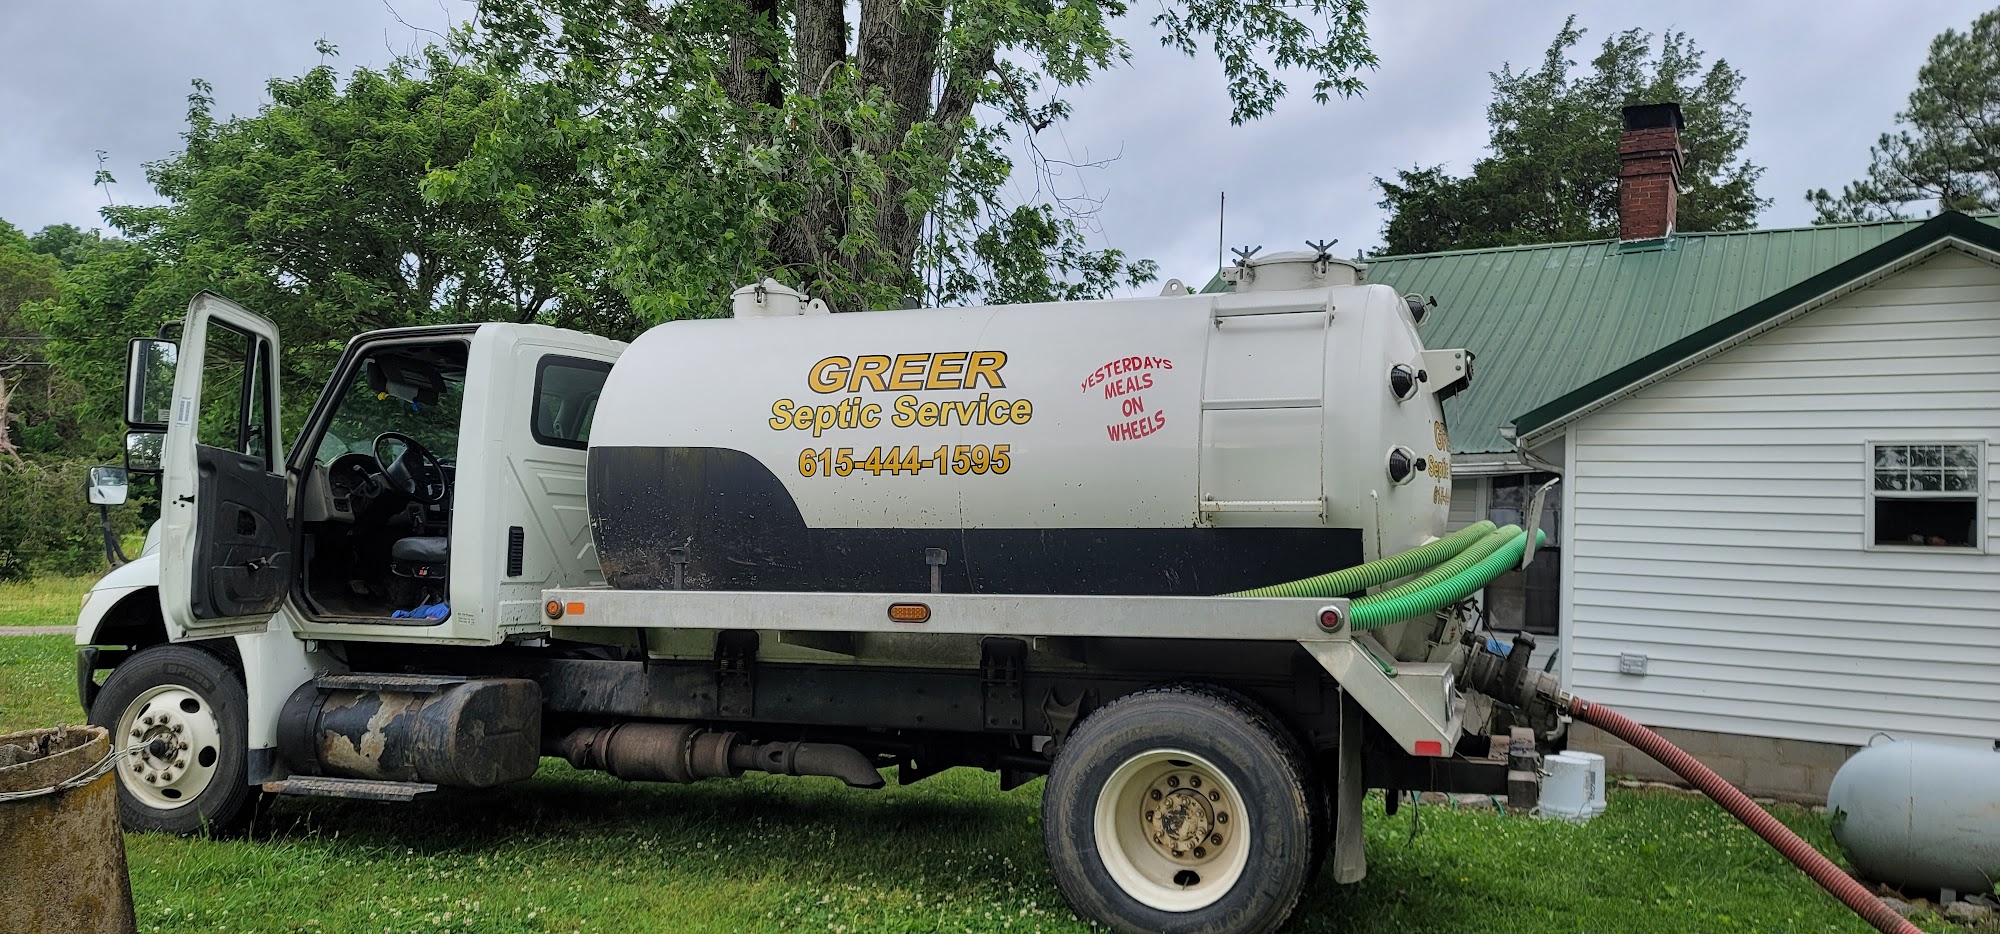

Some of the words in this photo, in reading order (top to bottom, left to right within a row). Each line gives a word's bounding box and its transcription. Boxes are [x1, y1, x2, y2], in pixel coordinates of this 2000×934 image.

[807, 351, 1008, 394] GREER
[1081, 356, 1173, 393] YESTERDAYS
[1104, 373, 1153, 400] MEALS
[768, 397, 882, 438] Septic
[891, 393, 1033, 427] Service
[1122, 396, 1144, 417] ON
[1106, 410, 1166, 441] WHEELS
[799, 444, 1011, 477] 615-444-1595
